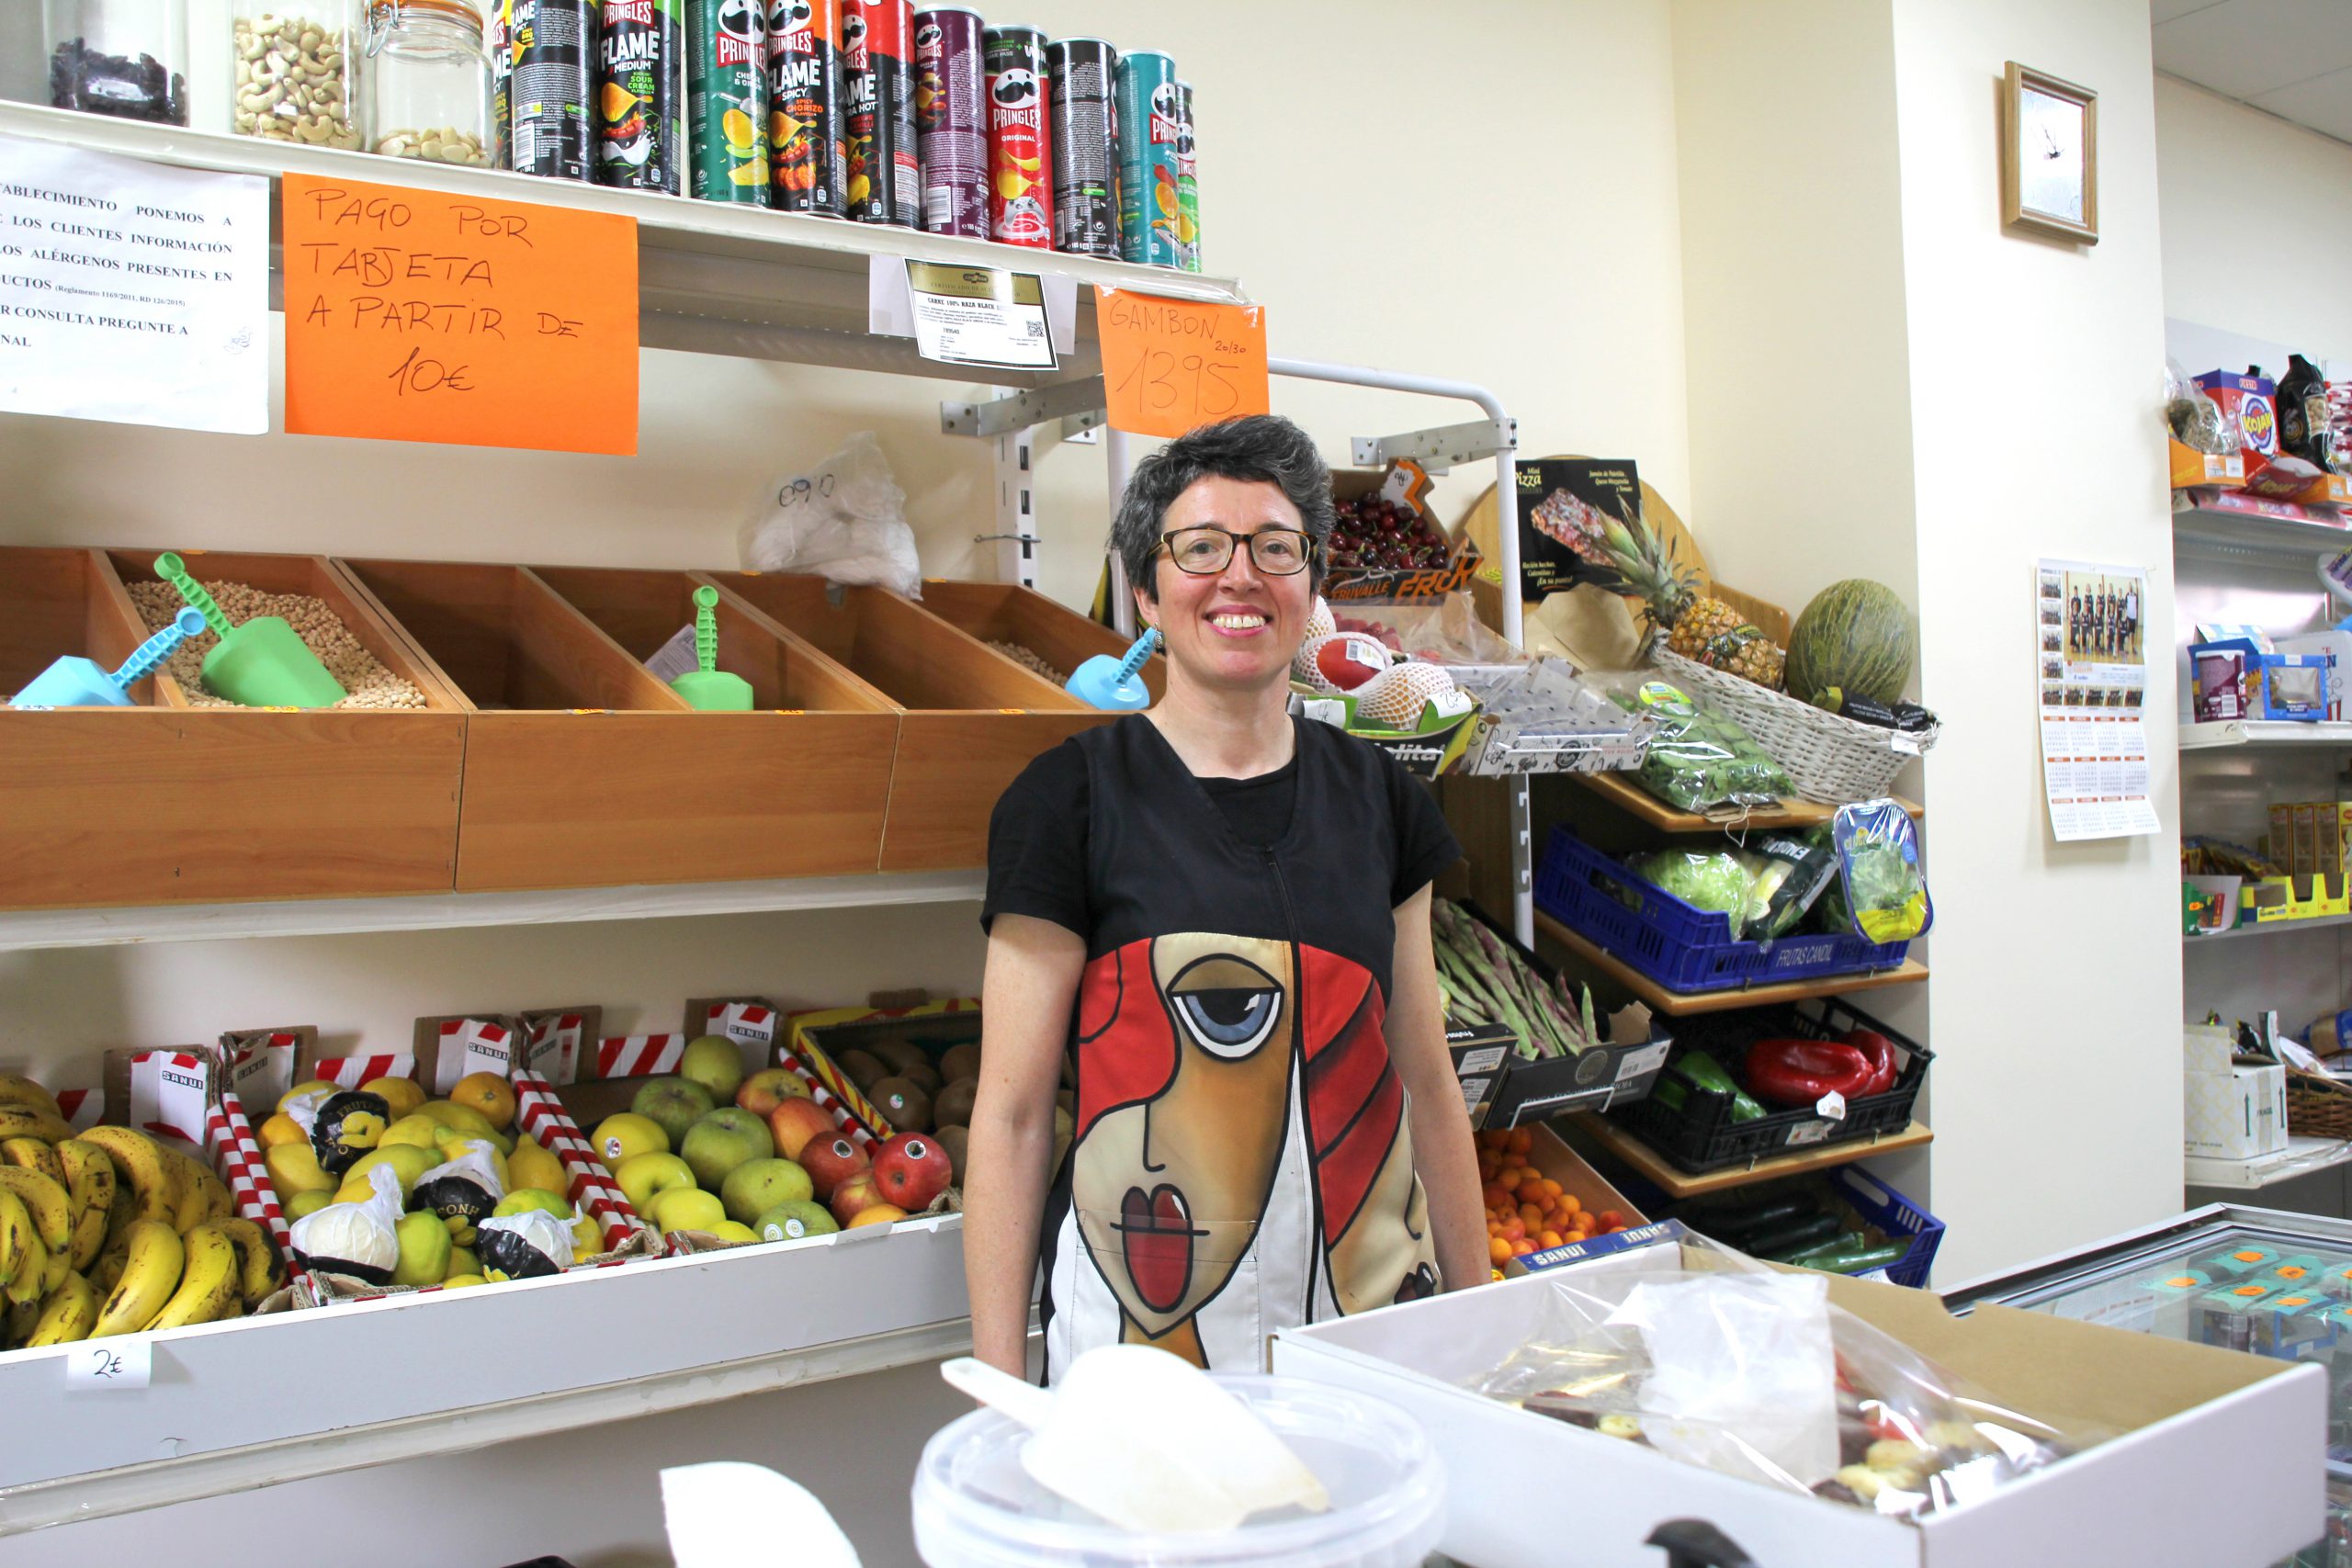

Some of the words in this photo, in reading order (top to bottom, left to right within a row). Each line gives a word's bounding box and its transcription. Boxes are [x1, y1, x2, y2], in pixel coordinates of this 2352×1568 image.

[604, 1, 652, 28] PRINGLES
[600, 30, 661, 72] FLAME
[768, 30, 812, 58] PRINGLES
[614, 61, 651, 73] MEDIUM
[628, 83, 655, 91] CREAM
[630, 75, 653, 84] SOUR
[782, 88, 808, 101] SPICY
[786, 104, 824, 113] CHORIZO
[858, 102, 876, 113] HOT
[993, 108, 1042, 131] PRINGLES
[1001, 134, 1036, 142] ORIGINAL
[136, 205, 205, 224] PONEMOS
[222, 217, 232, 227] A
[305, 188, 412, 231] PAGO
[449, 205, 533, 248] POR
[13, 215, 42, 230] LOS
[51, 221, 123, 242] CLIENTES
[130, 233, 232, 254] INFORMACIÓN
[0, 244, 23, 257] OS
[30, 248, 120, 270] ALÉRGENOS
[127, 262, 207, 280] PRESENTES
[214, 271, 232, 282] EN
[140, 295, 152, 303] RD
[15, 306, 95, 325] CONSULTA
[99, 315, 175, 333] PREGUNTE
[178, 326, 189, 335] A
[307, 294, 332, 327] A
[537, 312, 584, 338] DE
[1109, 299, 1221, 341] GAMBON
[389, 346, 476, 396] 10€
[2242, 412, 2272, 434] KOJAK
[1776, 945, 1807, 967] FRUTAS
[1807, 944, 1834, 963] CANDIL
[469, 1042, 508, 1061] SANUI
[162, 1070, 204, 1090] SANUI
[1532, 1243, 1589, 1266] SANUI
